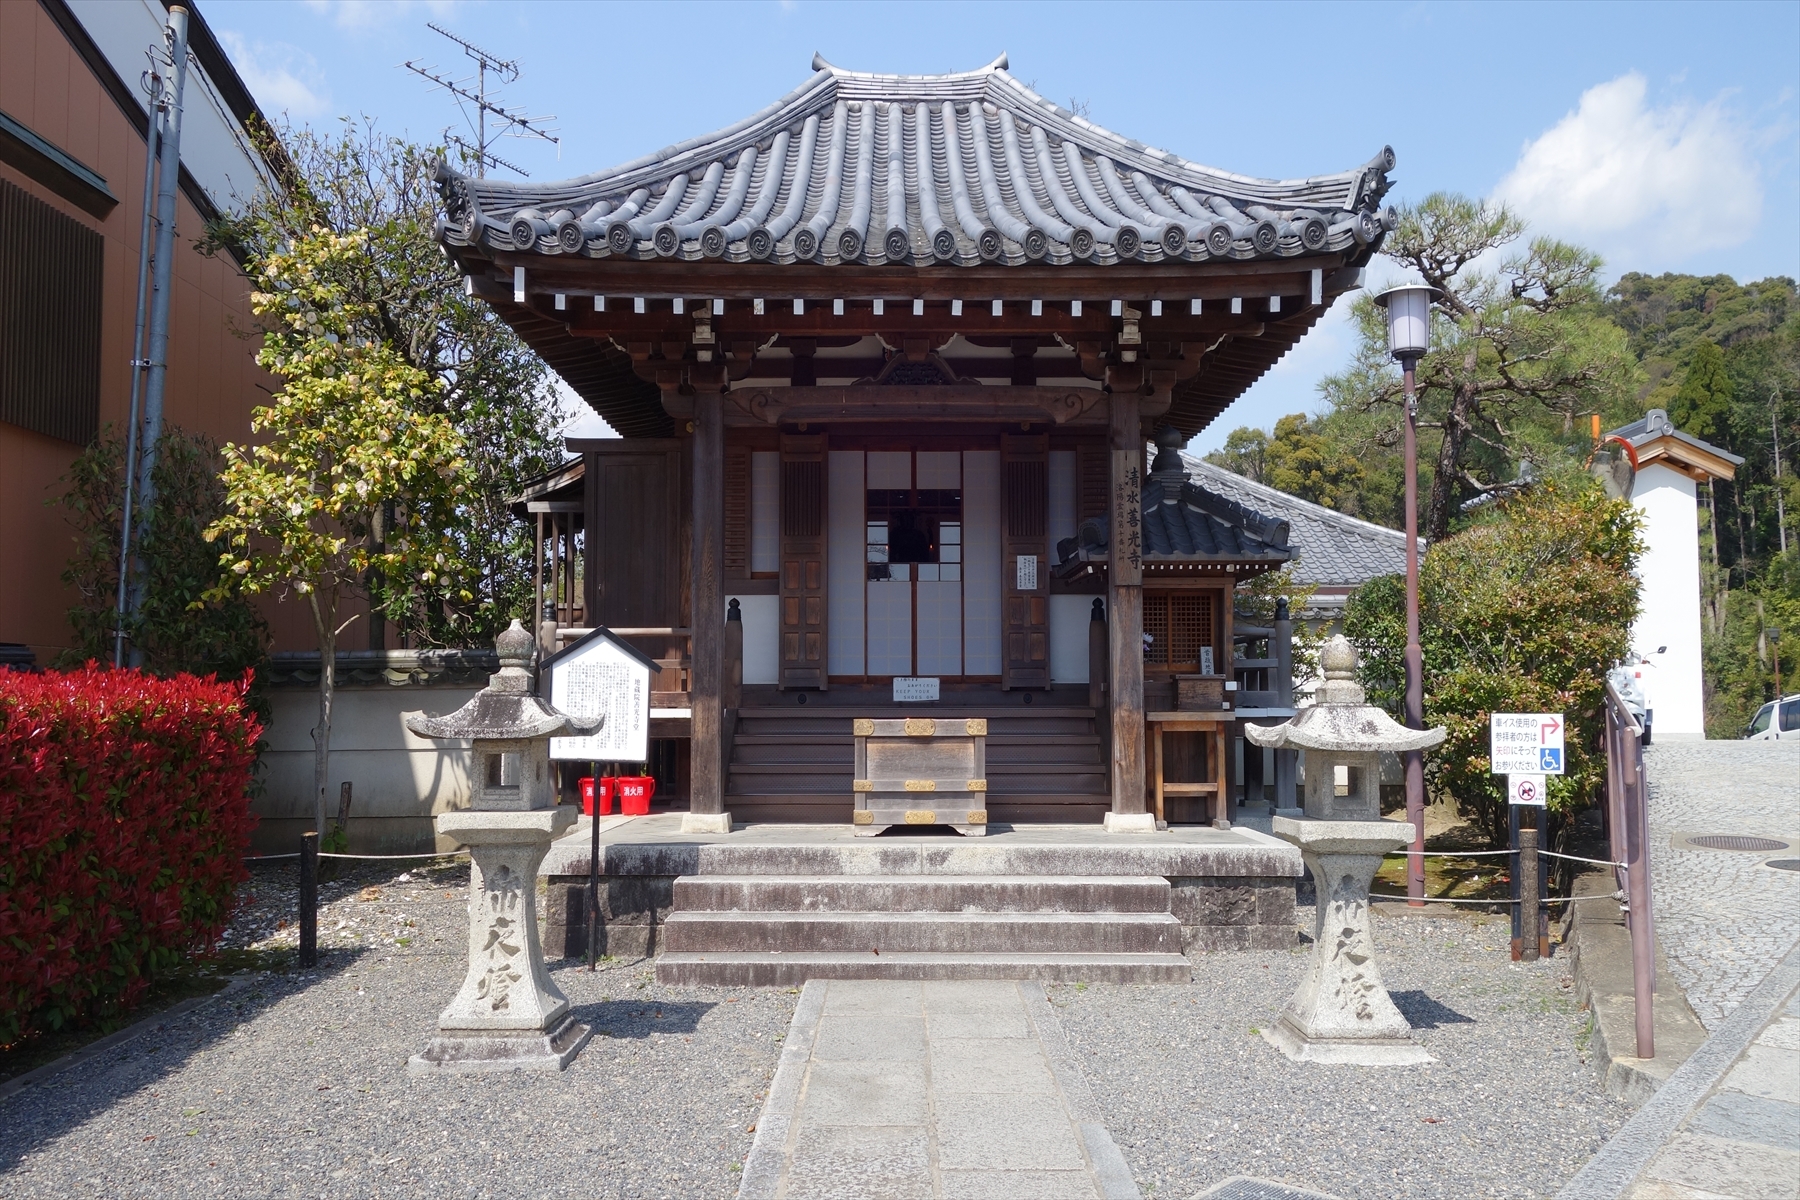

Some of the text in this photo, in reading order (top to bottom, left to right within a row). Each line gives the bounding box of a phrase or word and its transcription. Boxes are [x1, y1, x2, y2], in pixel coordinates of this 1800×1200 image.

[1125, 466, 1141, 570] 清水善光寺
[633, 678, 641, 731] 地蔵院善光寺堂
[1495, 718, 1538, 728] 車イス使用の
[1495, 732, 1537, 742] 参拝者の方は
[1495, 745, 1537, 756] 矢印にそって
[1495, 760, 1538, 771] お参りください
[586, 786, 607, 797] 消用
[623, 786, 644, 797] 消火用
